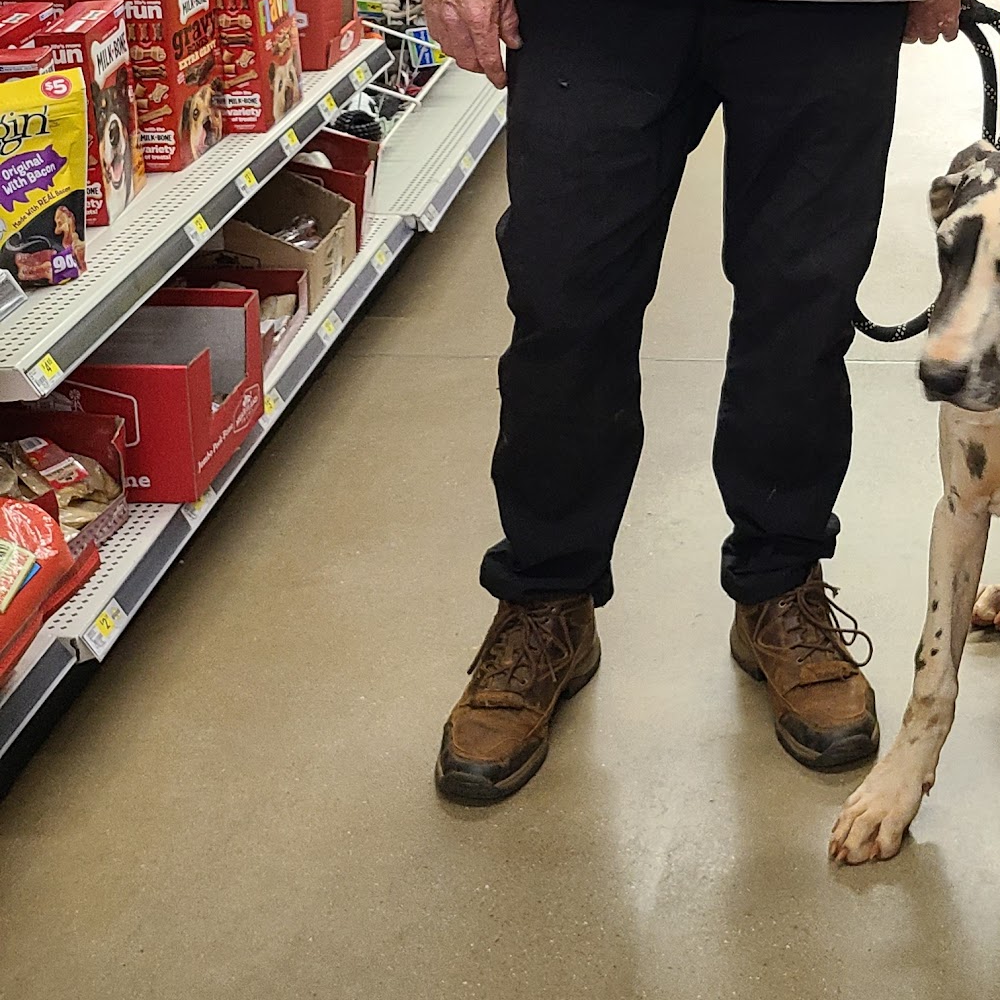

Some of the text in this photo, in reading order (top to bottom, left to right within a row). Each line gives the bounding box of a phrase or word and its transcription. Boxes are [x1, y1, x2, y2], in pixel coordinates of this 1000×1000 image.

[125, 0, 163, 20] fun
[52, 48, 83, 64] un
[96, 32, 127, 76] MILK-BONE
[44, 79, 68, 95] $5
[140, 134, 172, 142] MILK-BONE
[1, 152, 44, 181] Original
[1, 162, 56, 196] With Bacon
[12, 213, 27, 229] Made
[26, 205, 39, 219] With
[38, 193, 54, 207] REAL
